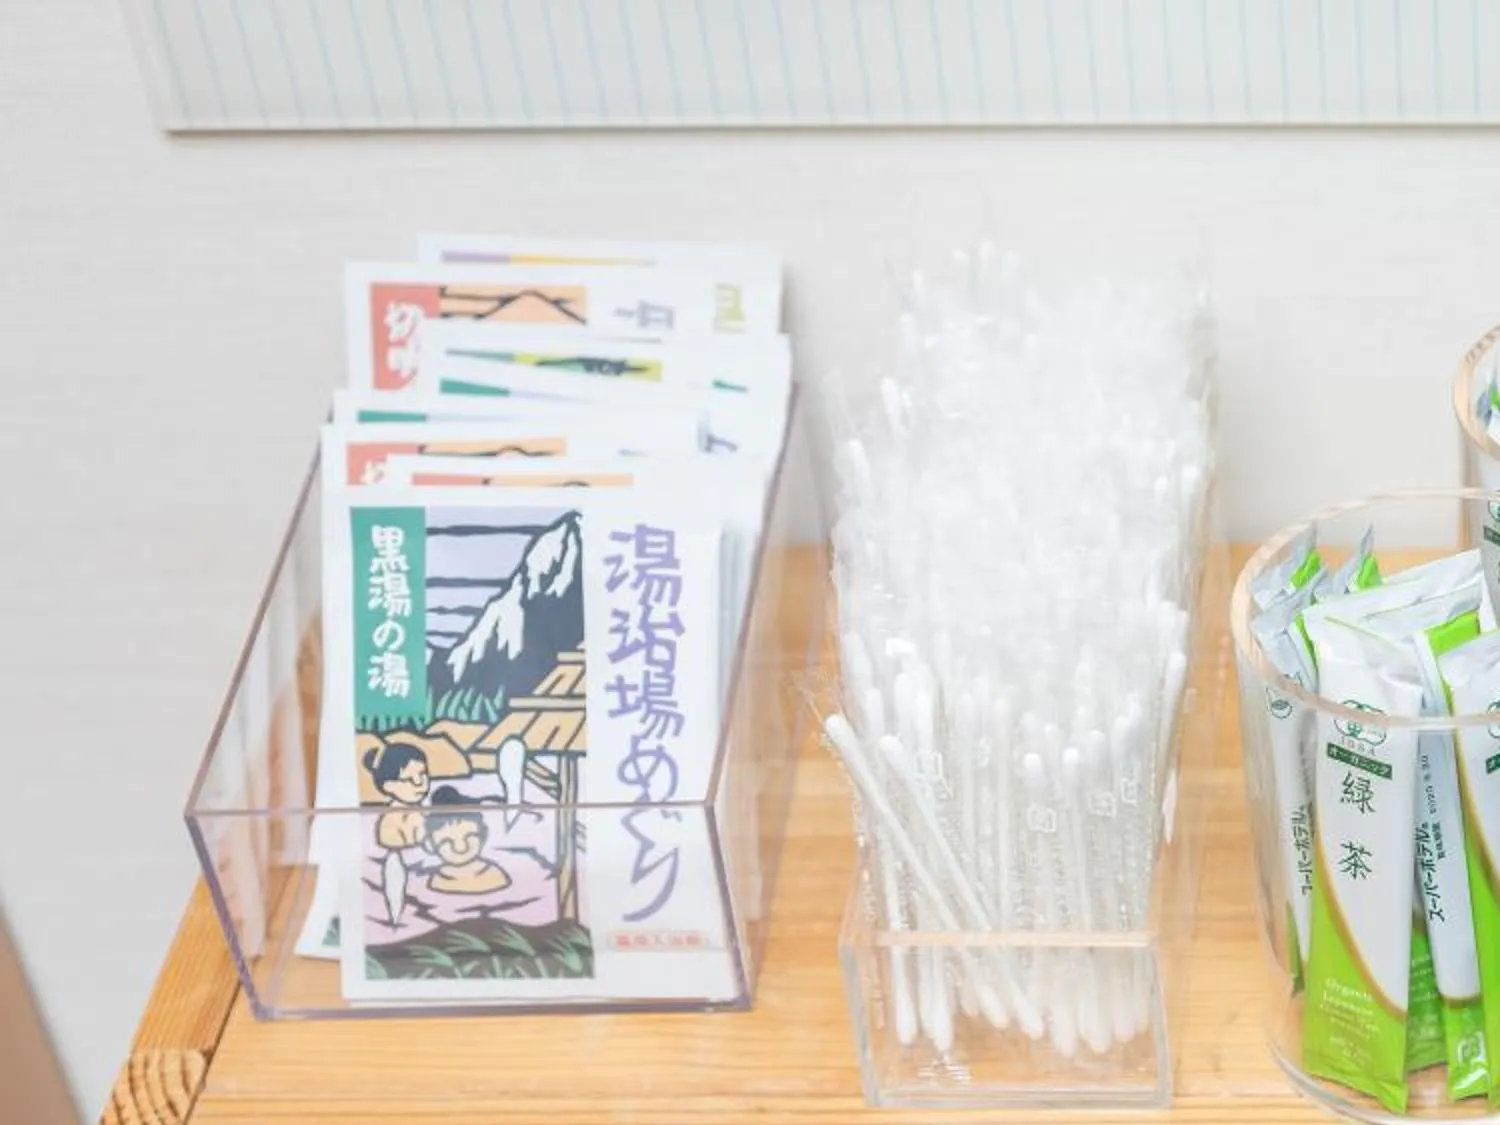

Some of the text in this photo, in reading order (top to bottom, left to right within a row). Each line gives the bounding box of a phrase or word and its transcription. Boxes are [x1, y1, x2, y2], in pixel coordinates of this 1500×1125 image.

[367, 524, 412, 699] 黒湯の湯
[602, 523, 686, 923] 湯治場めぐり
[1338, 770, 1375, 880] 緑茶
